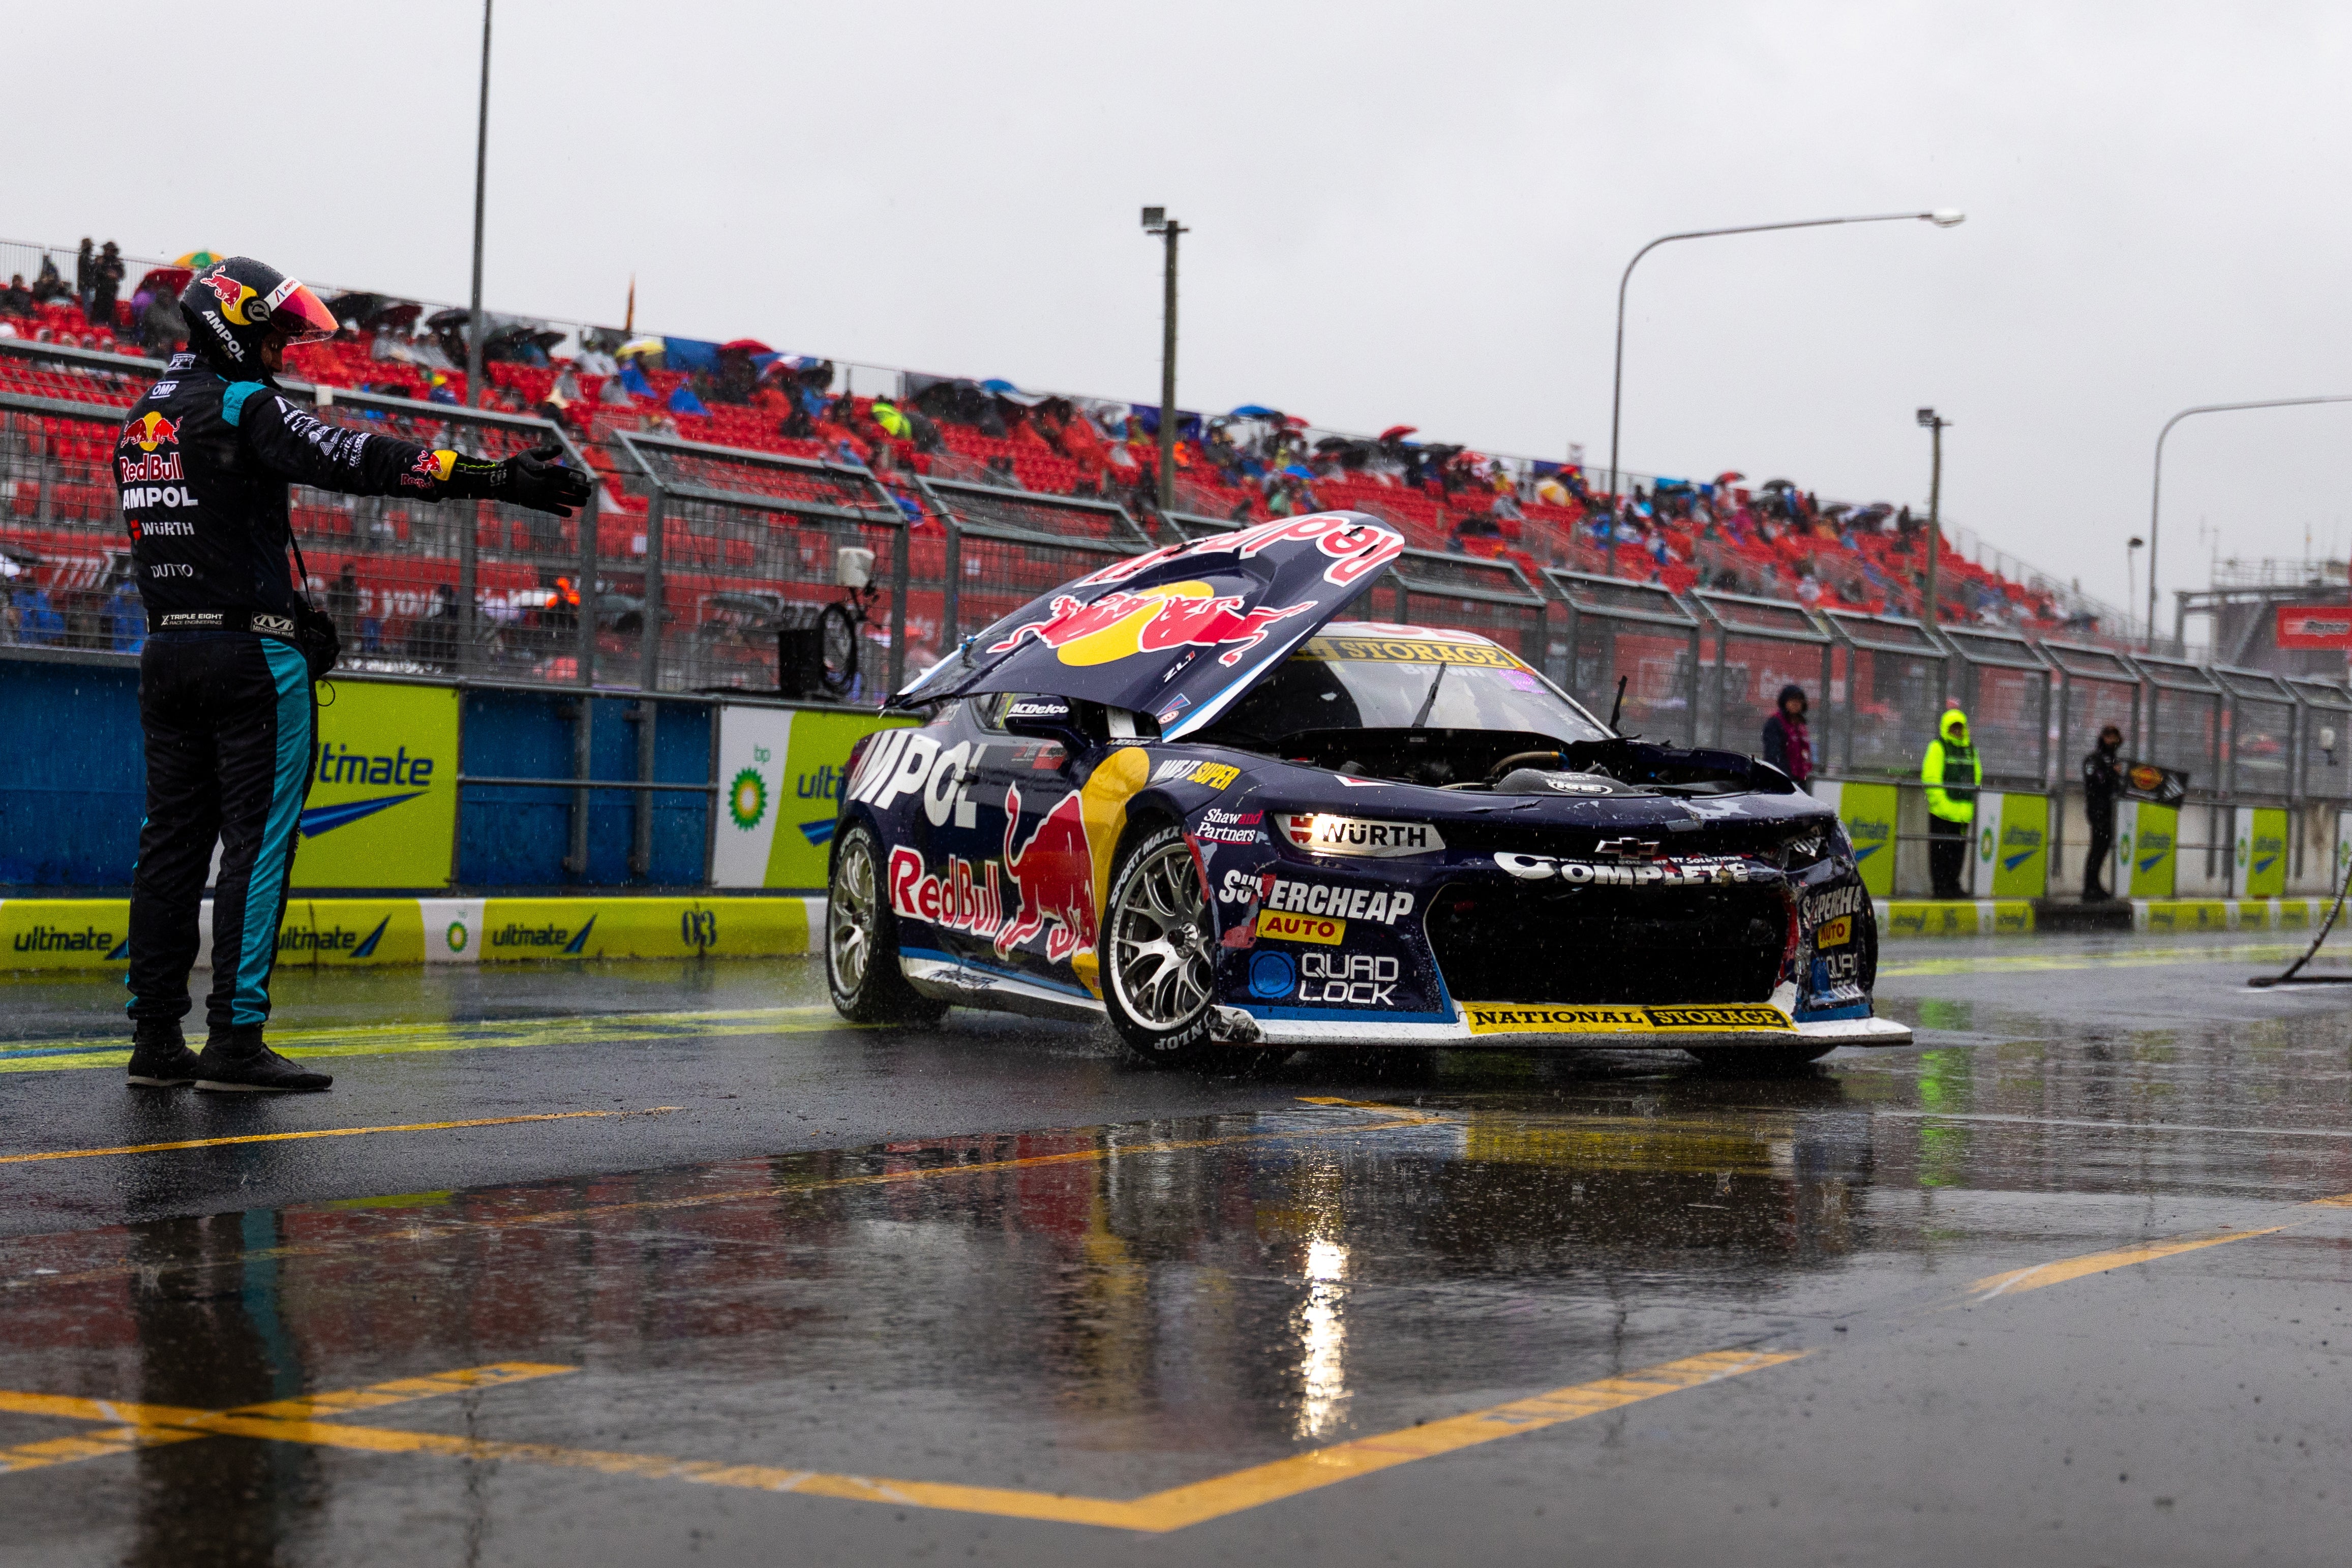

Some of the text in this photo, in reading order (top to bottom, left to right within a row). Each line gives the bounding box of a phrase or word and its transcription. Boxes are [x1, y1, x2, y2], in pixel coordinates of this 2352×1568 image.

[202, 310, 245, 363] AMPOL
[152, 383, 177, 396] OMP
[119, 451, 185, 484] Red Bull
[123, 486, 199, 510] AMPOL
[141, 522, 195, 536] WÜRTH
[150, 564, 194, 579] DUTTO
[1163, 650, 1196, 683] ZL1
[1339, 641, 1509, 667] STORAGE
[1009, 703, 1069, 715] ACDelco
[318, 742, 434, 787] timate
[1186, 761, 1241, 791] SUPER
[797, 765, 845, 794] ulti
[1203, 808, 1263, 825] Shaw and
[1194, 822, 1256, 843] Partners
[1322, 823, 1427, 848] WÜRTH
[888, 844, 1003, 938] Red Bull
[14, 925, 113, 952] ultimate
[492, 923, 568, 946] ultimate
[681, 910, 717, 948] 03
[1264, 916, 1336, 939] AUTO
[1820, 923, 1846, 941] AUTO
[1302, 952, 1399, 982] QUAD
[1298, 979, 1398, 1006] LOCK
[1474, 1009, 1778, 1027] NATIONAL STORAGE
